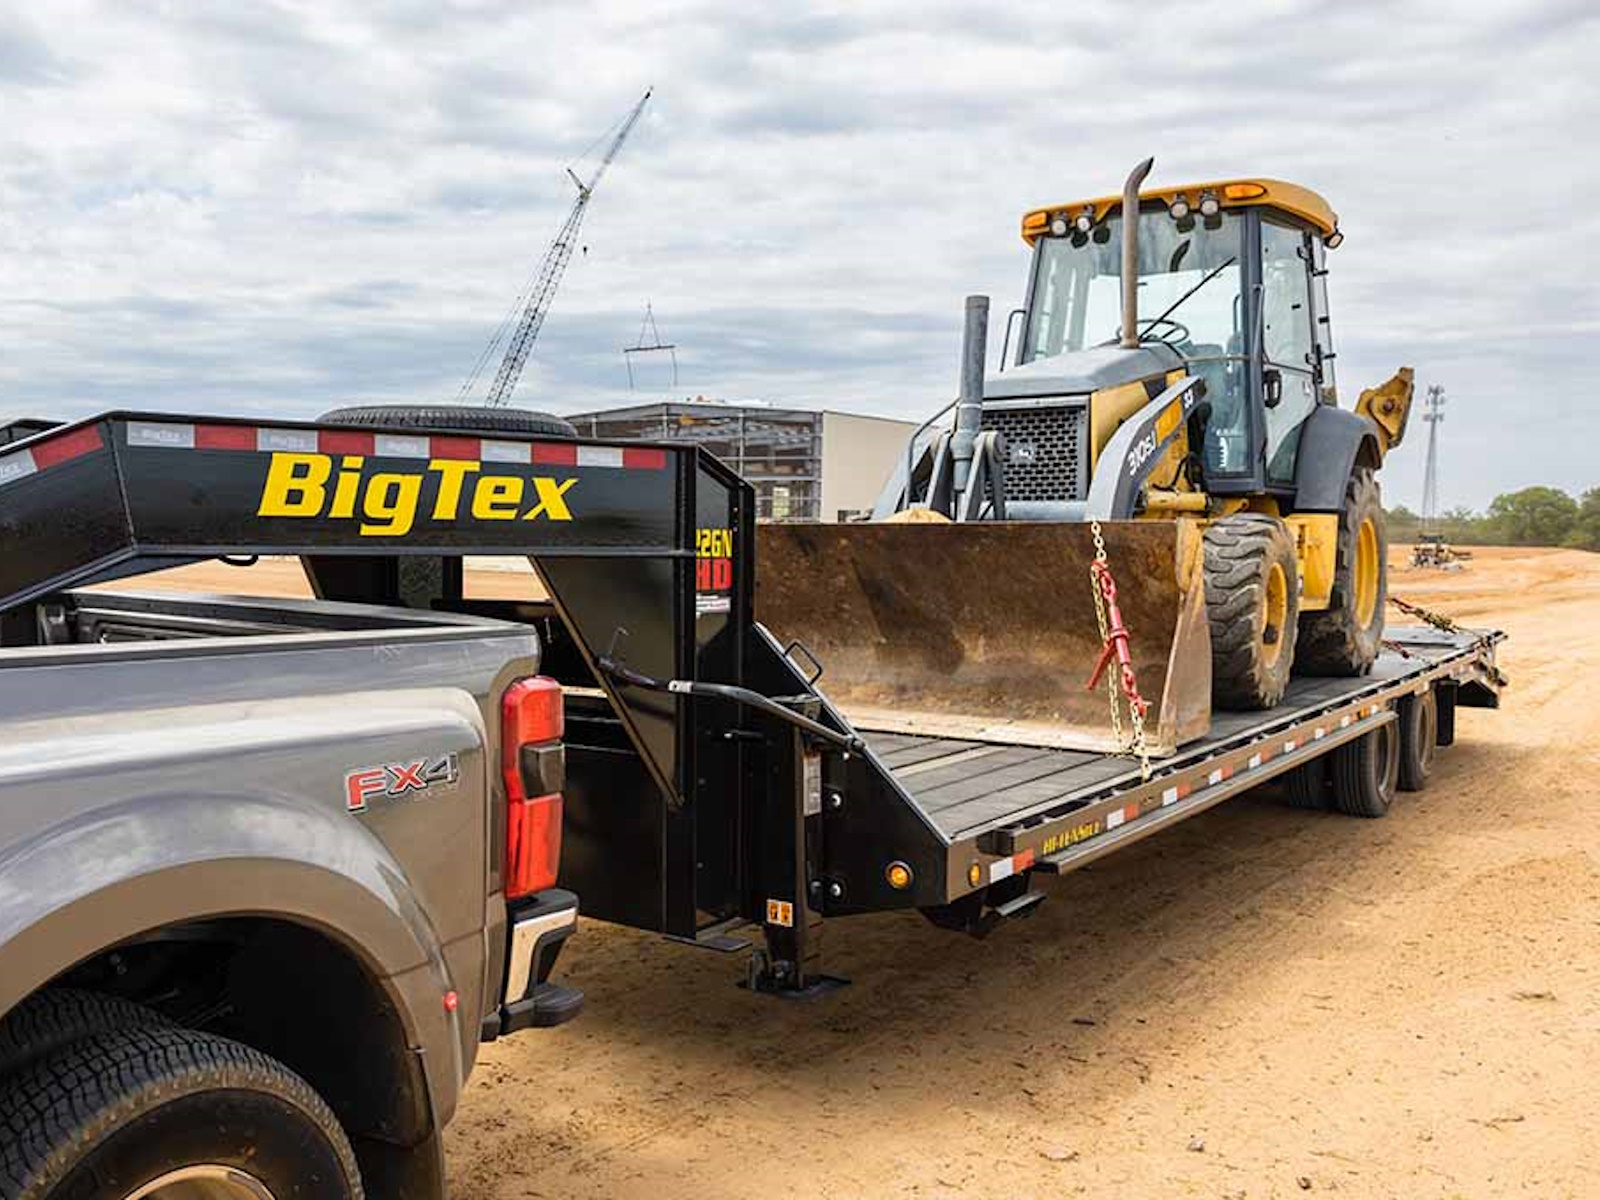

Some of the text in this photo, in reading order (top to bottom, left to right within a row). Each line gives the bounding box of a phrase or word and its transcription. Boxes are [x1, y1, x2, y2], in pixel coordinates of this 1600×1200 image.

[257, 452, 579, 536] BigTex
[696, 558, 733, 590] HD
[345, 752, 458, 812] FX4
